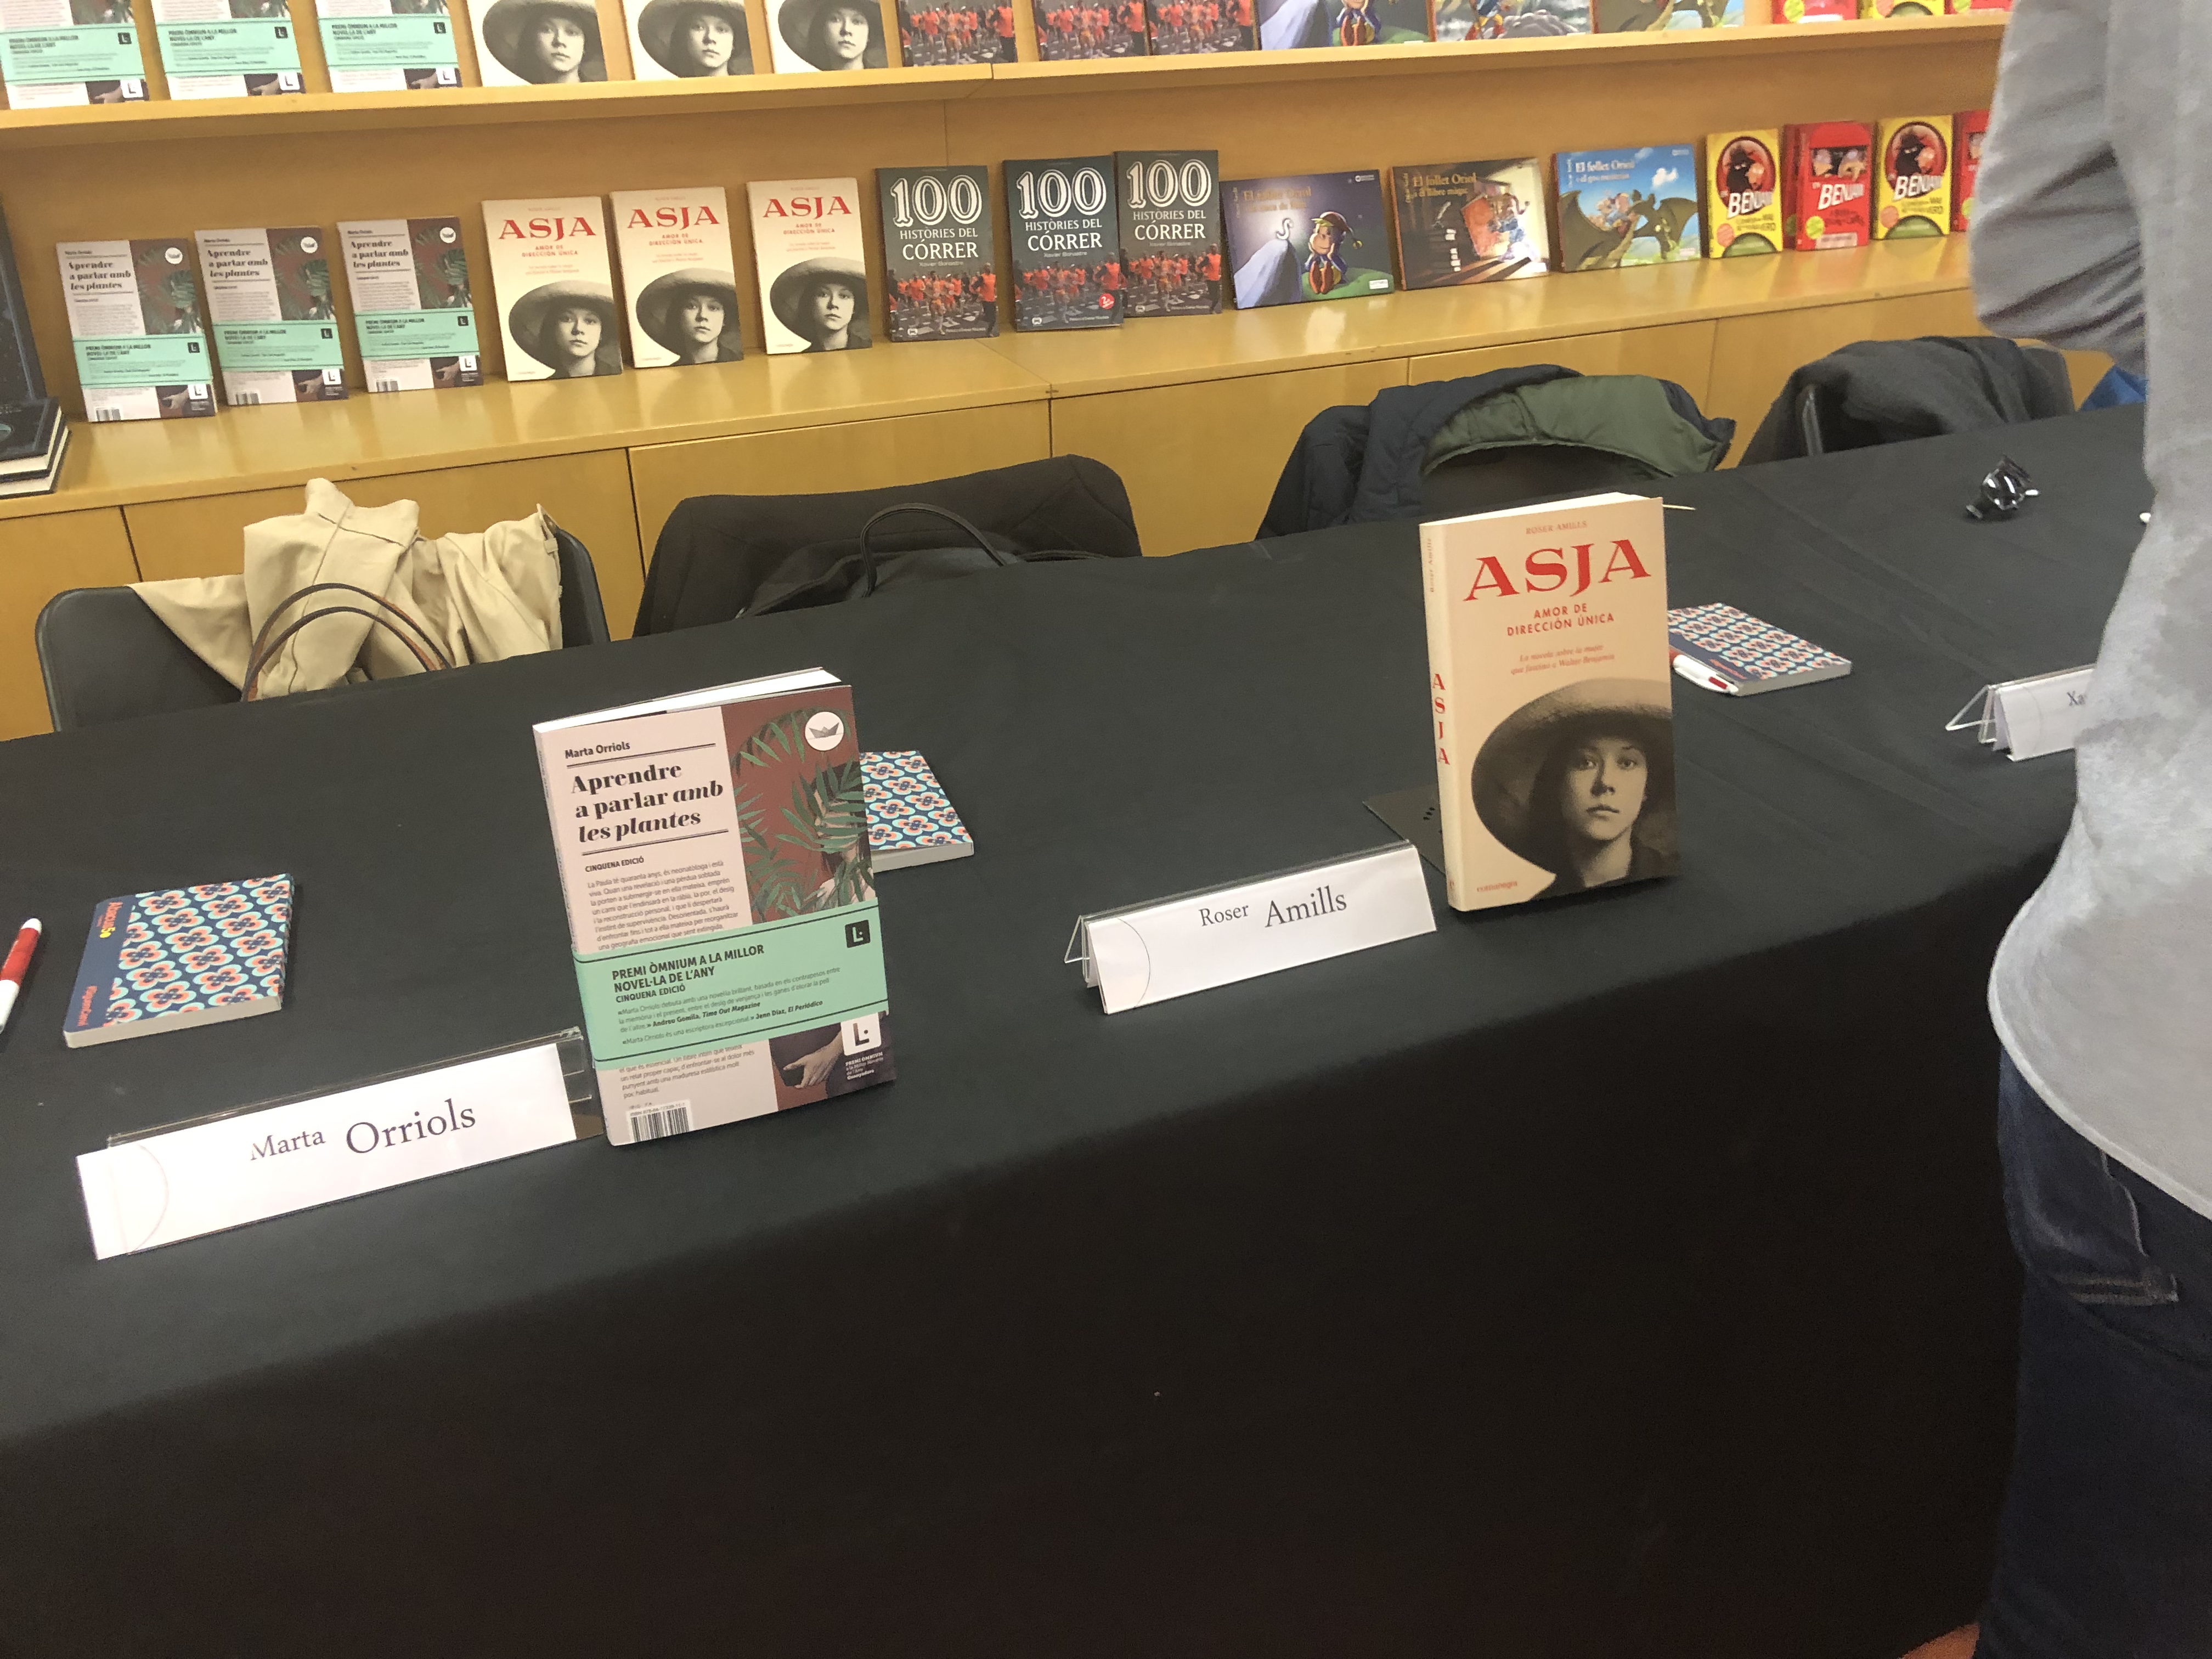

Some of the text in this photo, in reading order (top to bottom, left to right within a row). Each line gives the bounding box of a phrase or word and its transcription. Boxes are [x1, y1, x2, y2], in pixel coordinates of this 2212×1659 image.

[1017, 167, 1107, 219] 100
[1126, 159, 1211, 208] 100
[763, 196, 852, 219] ASJA
[890, 175, 982, 227] 100
[627, 206, 720, 230] ASJA
[1025, 218, 1102, 231] HISTÒRIES DEL
[1133, 208, 1206, 220] HISTÒRIES DEL
[498, 217, 596, 241] ASJA
[900, 227, 978, 239] HISTÒRIES DEL
[1028, 230, 1102, 251] CÓRRER
[1135, 220, 1206, 240] CÓRRER
[902, 239, 979, 260] CÓRRER
[1526, 521, 1588, 535] ROSER AMILLS
[1463, 539, 1652, 601] ASJA
[1533, 603, 1588, 619] AMOR DE
[1507, 613, 1615, 636] DIRECCIÓN ÚNICA
[1531, 650, 1554, 660] novela
[565, 741, 630, 759] Marta Orriols
[571, 764, 682, 795] Aprendre
[575, 780, 724, 820] a parlar amb
[578, 812, 701, 843] les plantes
[585, 855, 644, 872] CINQUENA EDICIÓ
[1199, 885, 1347, 928] Roser Amills
[612, 948, 765, 980] PREMI ÒMNIUM A LA MILLOR
[669, 972, 683, 983] DE
[616, 984, 686, 1003] CINQUENA EDICIÓ
[653, 1018, 675, 1027] Andreu
[731, 1002, 760, 1012] Magazine
[755, 1011, 770, 1019] Jenn
[795, 1000, 823, 1012] Periódico
[250, 1097, 477, 1161] Marta Orriols
